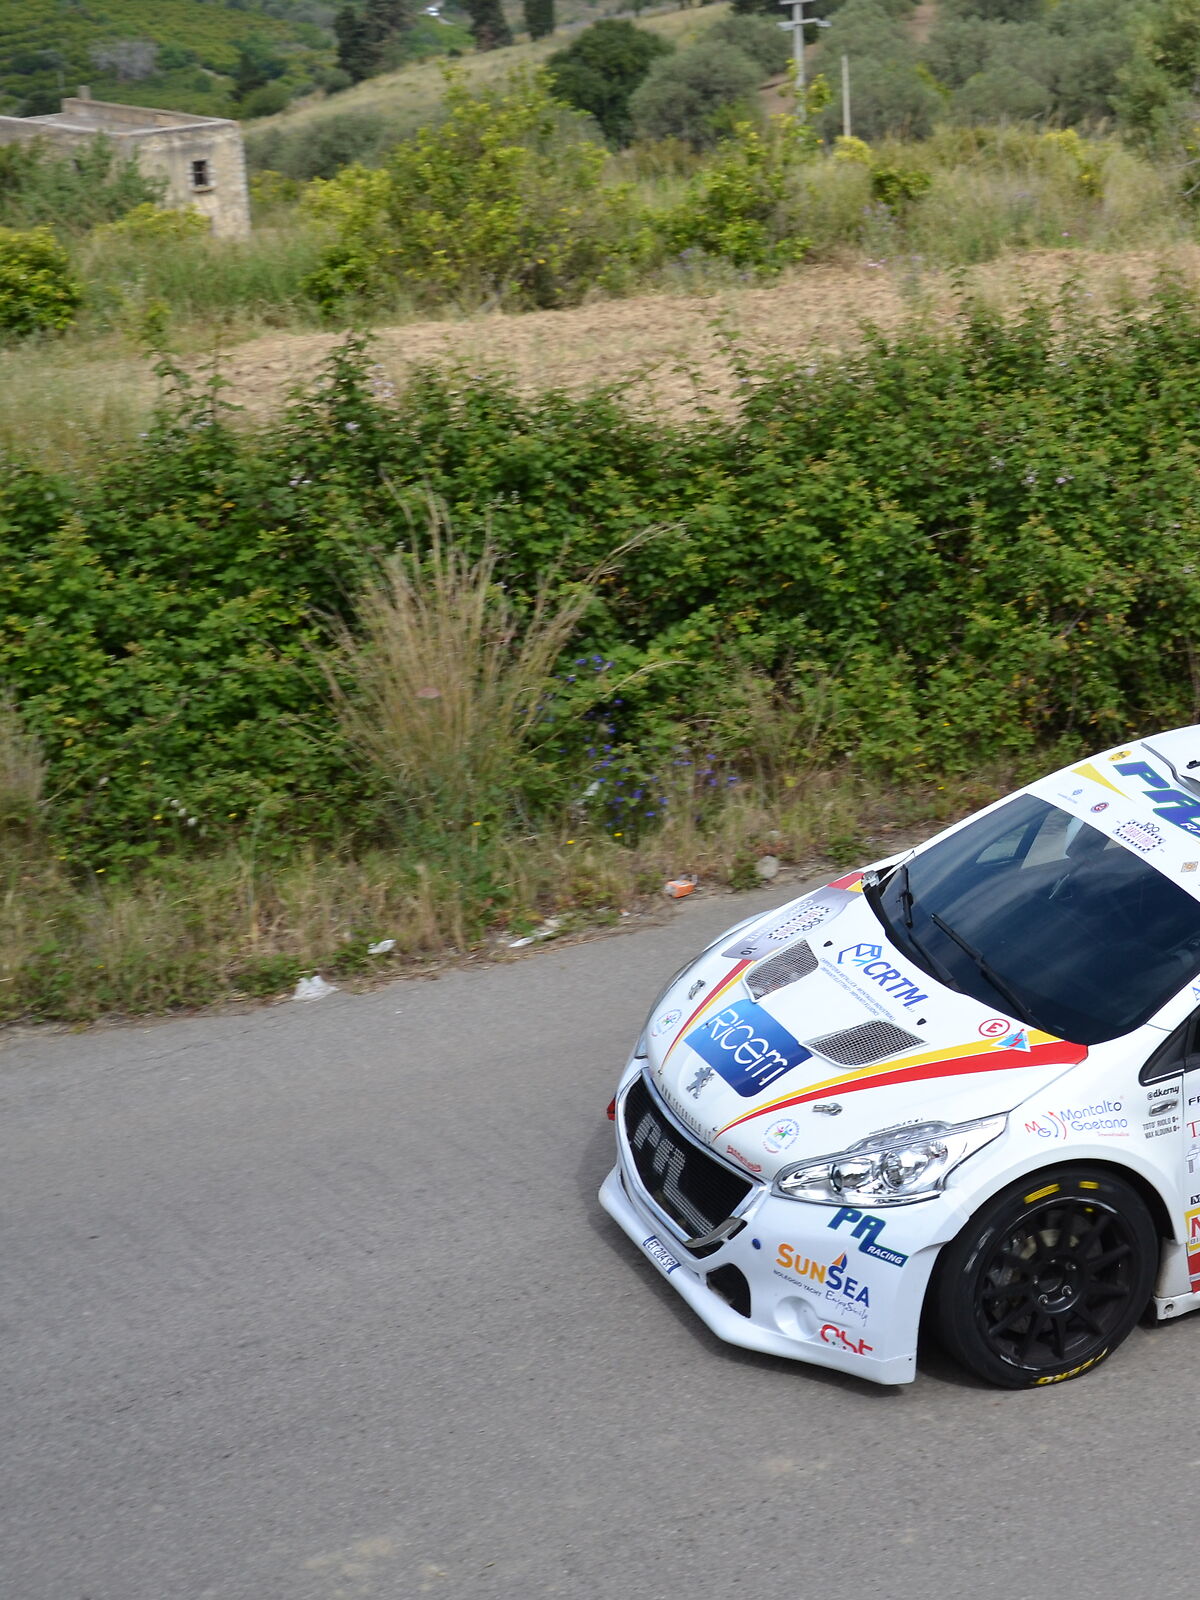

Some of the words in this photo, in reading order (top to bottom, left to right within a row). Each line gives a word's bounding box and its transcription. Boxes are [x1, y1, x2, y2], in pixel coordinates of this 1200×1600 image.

[862, 961, 929, 1007] CRTM
[1060, 1100, 1122, 1123] Montalto
[1071, 1117, 1128, 1131] Gaetano
[866, 1245, 904, 1264] RACING
